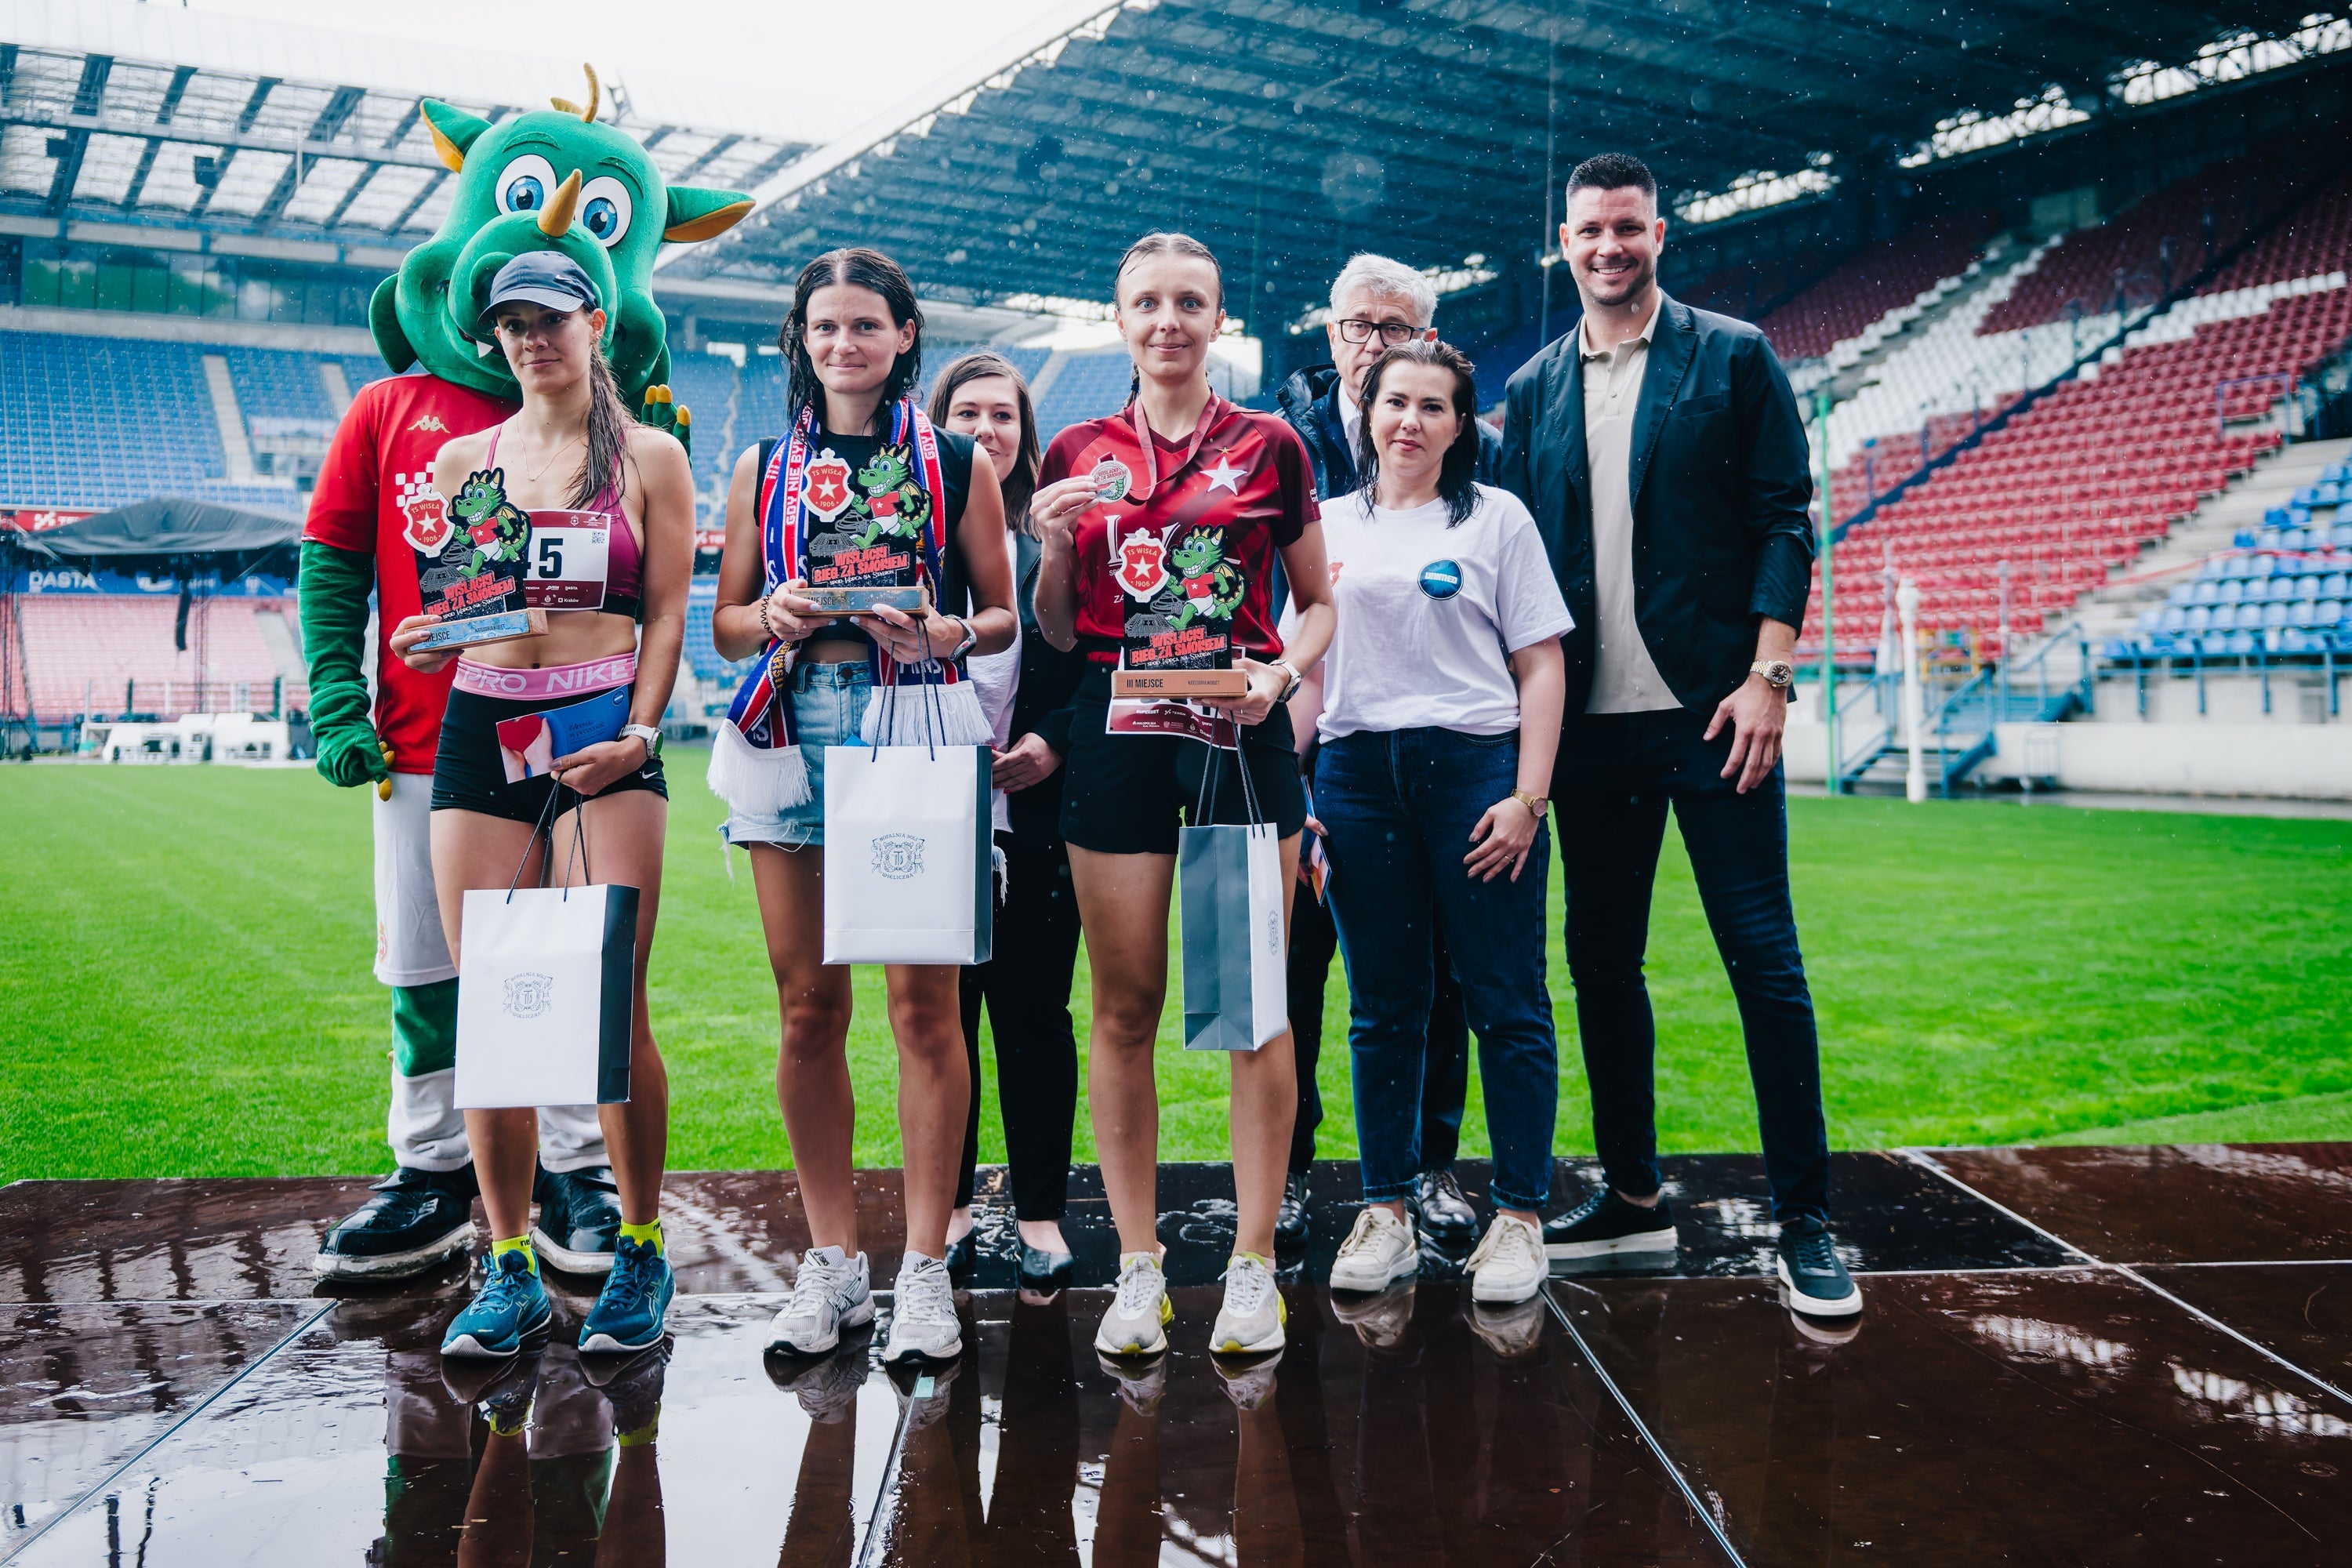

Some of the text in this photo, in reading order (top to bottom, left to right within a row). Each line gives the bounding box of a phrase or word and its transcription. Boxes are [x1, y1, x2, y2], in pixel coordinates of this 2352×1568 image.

[920, 436, 935, 460] GDY
[787, 467, 800, 492] NIE
[786, 495, 798, 525] GDY
[1136, 547, 1157, 556] WISŁA
[814, 554, 908, 583] BIEG ZA SMOKIEM
[29, 571, 96, 592] DASTA
[426, 578, 514, 616] BIEG ZA SMOKIEM
[1131, 637, 1225, 663] BIEG ZA SMOKIEM
[462, 659, 628, 693] PRO NIKE
[1134, 678, 1163, 688] MIEJSCE
